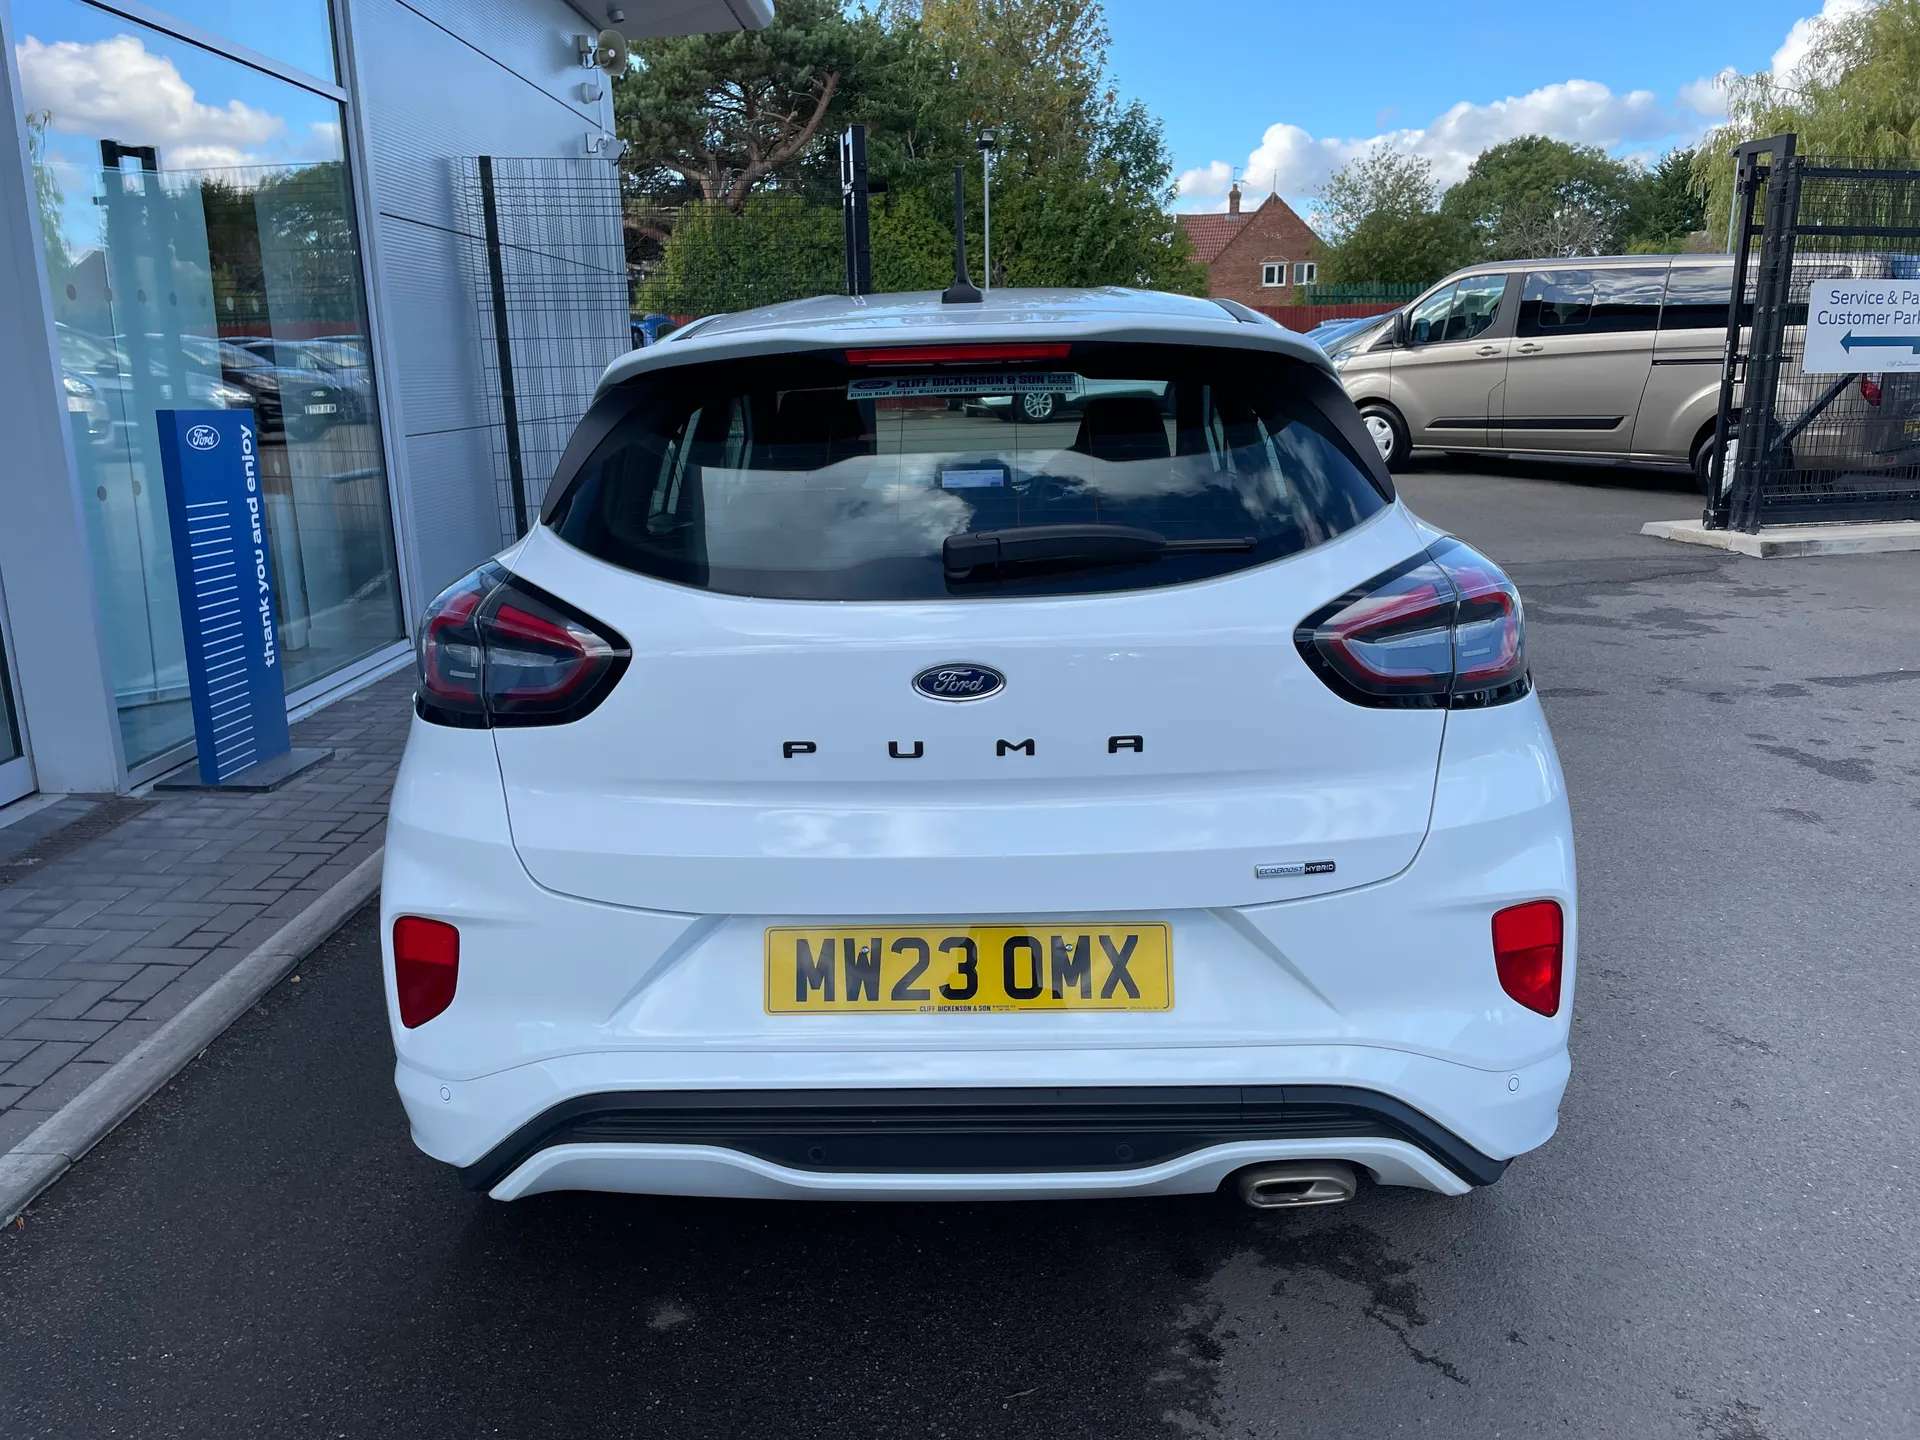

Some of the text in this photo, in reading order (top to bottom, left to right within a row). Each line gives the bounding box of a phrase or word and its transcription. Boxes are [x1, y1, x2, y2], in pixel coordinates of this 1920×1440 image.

[1830, 290, 1884, 305] Service
[1887, 290, 1898, 305] &
[1817, 310, 1920, 325] Customer Par
[192, 428, 215, 446] Ford
[240, 424, 275, 668] thank you and enjoy
[933, 670, 984, 693] Ford
[783, 735, 1144, 759] PUMA
[1305, 864, 1335, 873] HYBRID
[795, 934, 1141, 1002] MW23 OMX
[978, 1004, 991, 1012] SON
